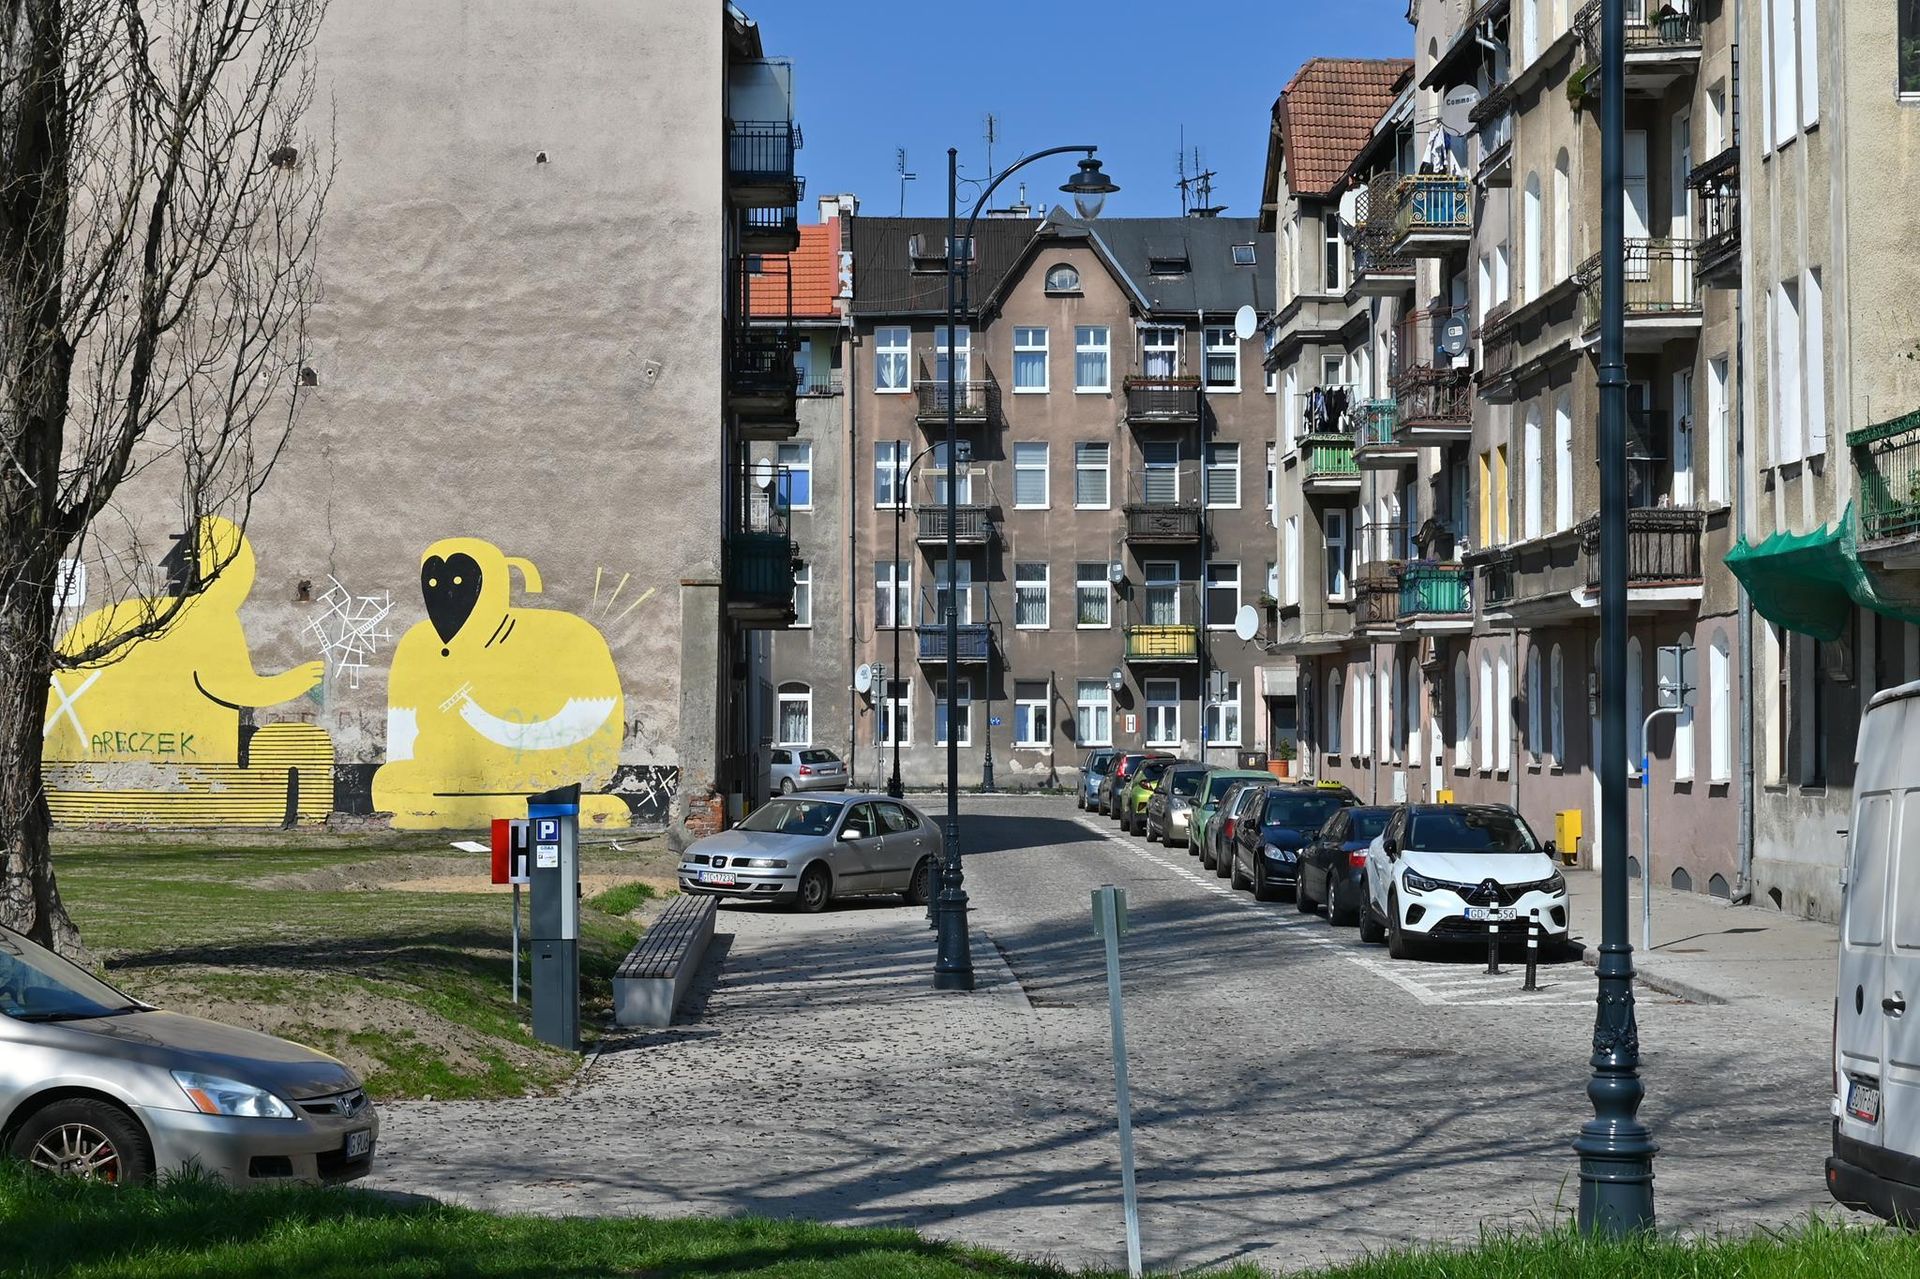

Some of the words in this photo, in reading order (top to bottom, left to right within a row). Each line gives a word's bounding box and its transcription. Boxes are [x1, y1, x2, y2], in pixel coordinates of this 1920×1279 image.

[92, 731, 196, 756] ARECZEK
[541, 821, 555, 839] P
[510, 826, 530, 877] H
